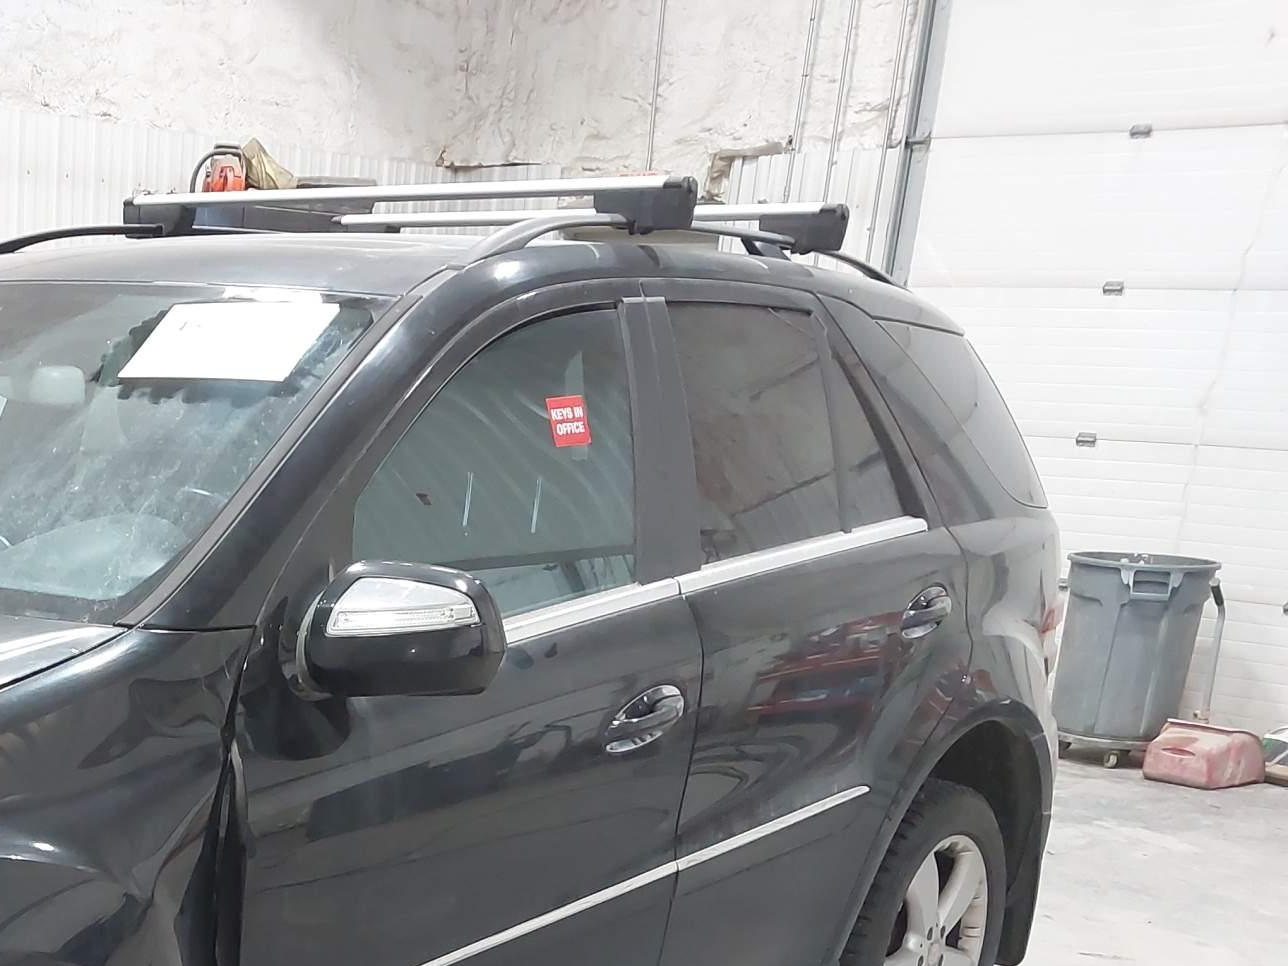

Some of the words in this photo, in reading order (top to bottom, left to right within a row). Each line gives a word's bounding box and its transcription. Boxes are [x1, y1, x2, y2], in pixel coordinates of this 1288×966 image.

[550, 407, 573, 420] KEYS
[574, 406, 584, 418] IN
[556, 421, 585, 435] OFFICE
